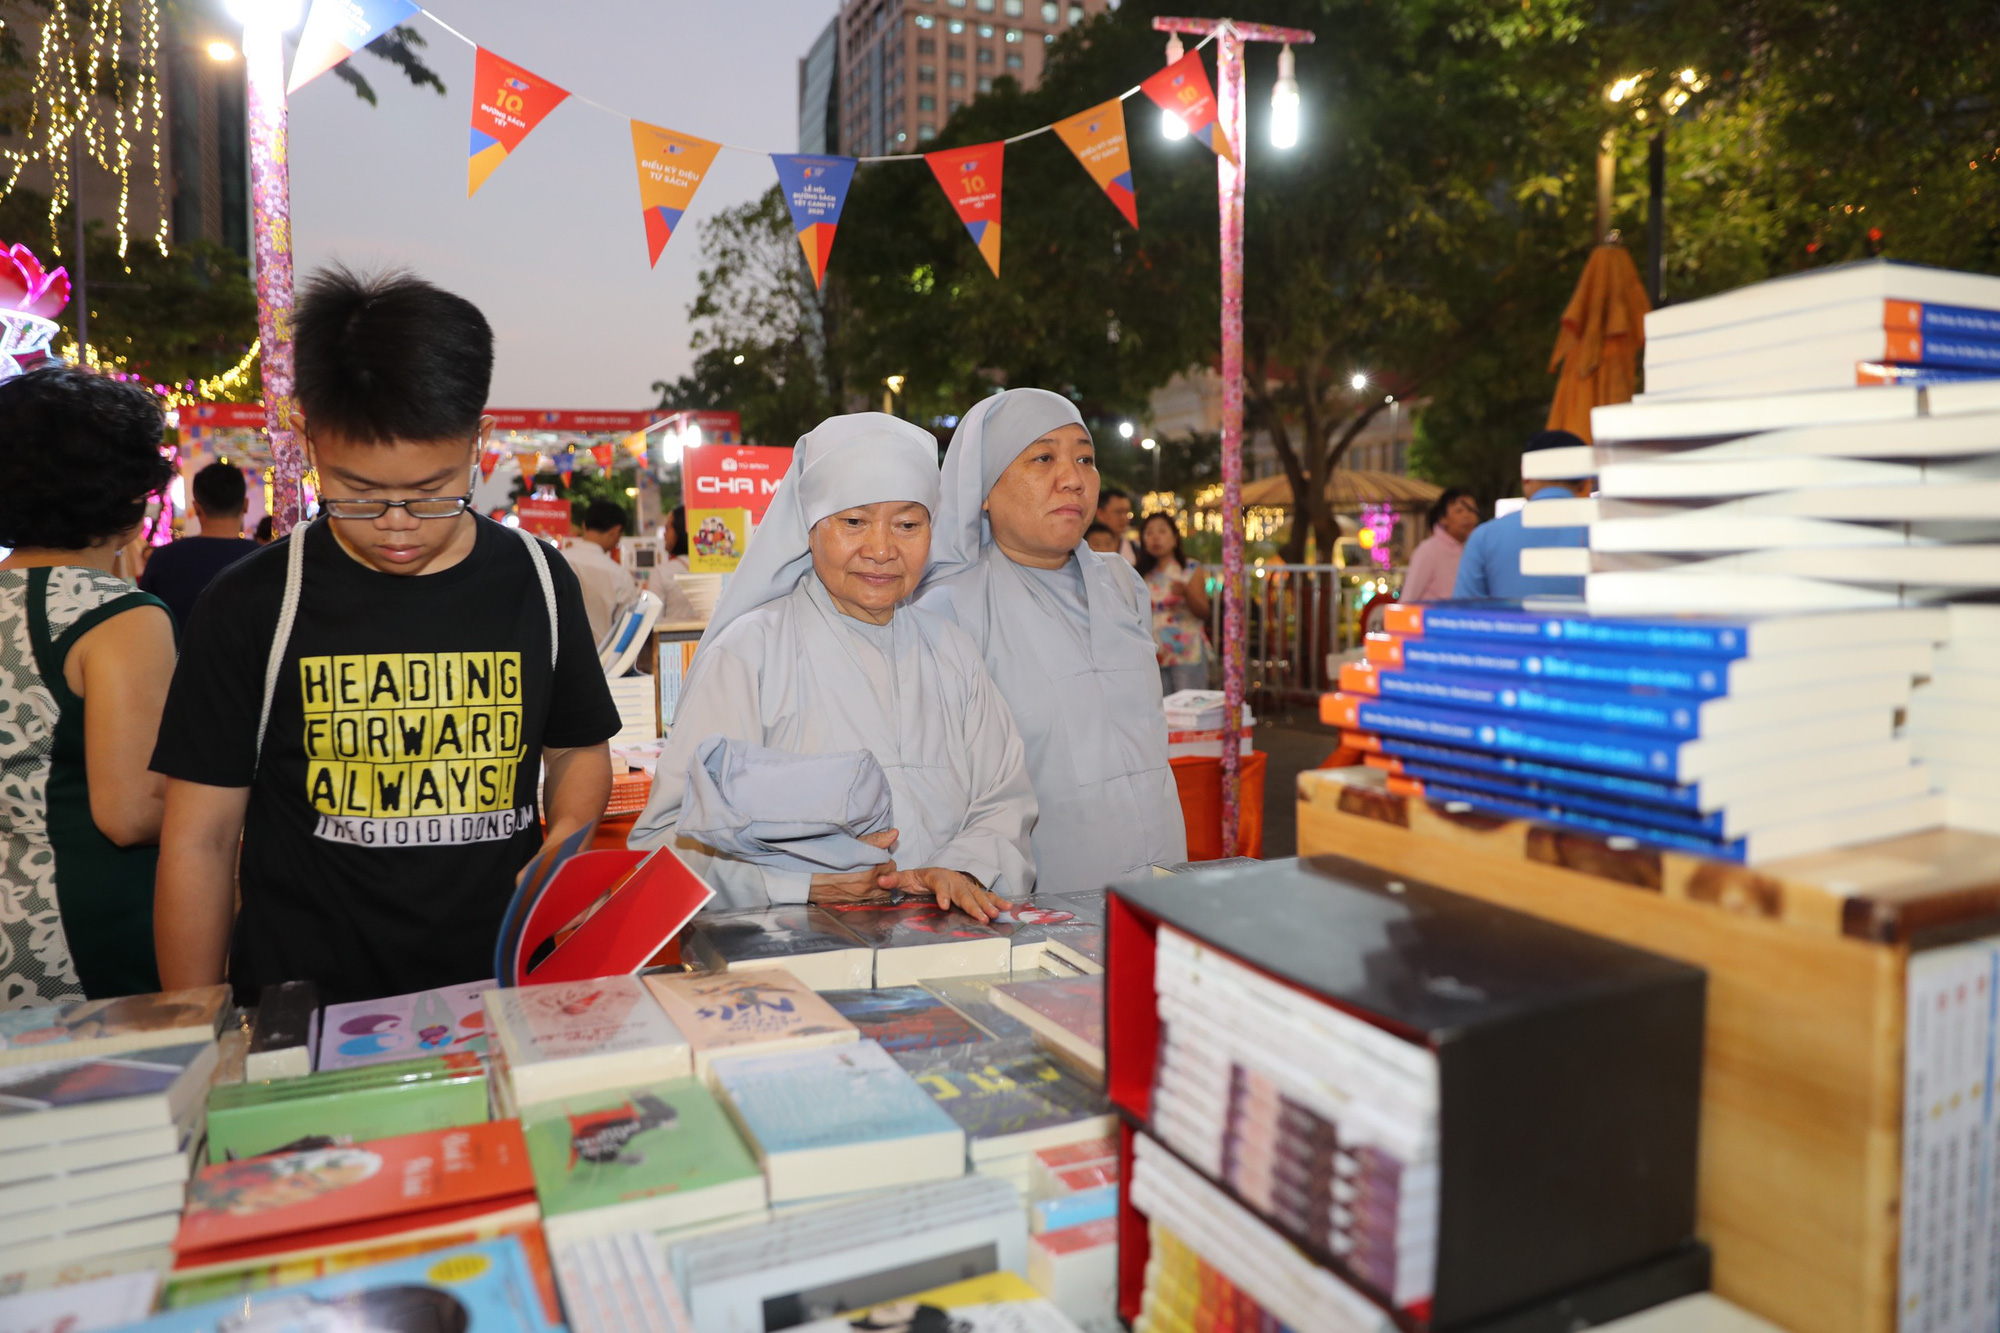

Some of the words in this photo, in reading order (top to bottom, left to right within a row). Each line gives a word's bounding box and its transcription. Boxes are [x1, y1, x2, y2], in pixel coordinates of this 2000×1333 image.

[495, 88, 523, 113] 10
[1177, 85, 1198, 106] 10
[507, 115, 526, 129] SÁCH
[664, 175, 689, 188] SÁCH
[961, 175, 986, 194] 10
[696, 476, 754, 494] CHA
[304, 658, 518, 704] HEADING
[311, 763, 513, 812] ALWAYS!
